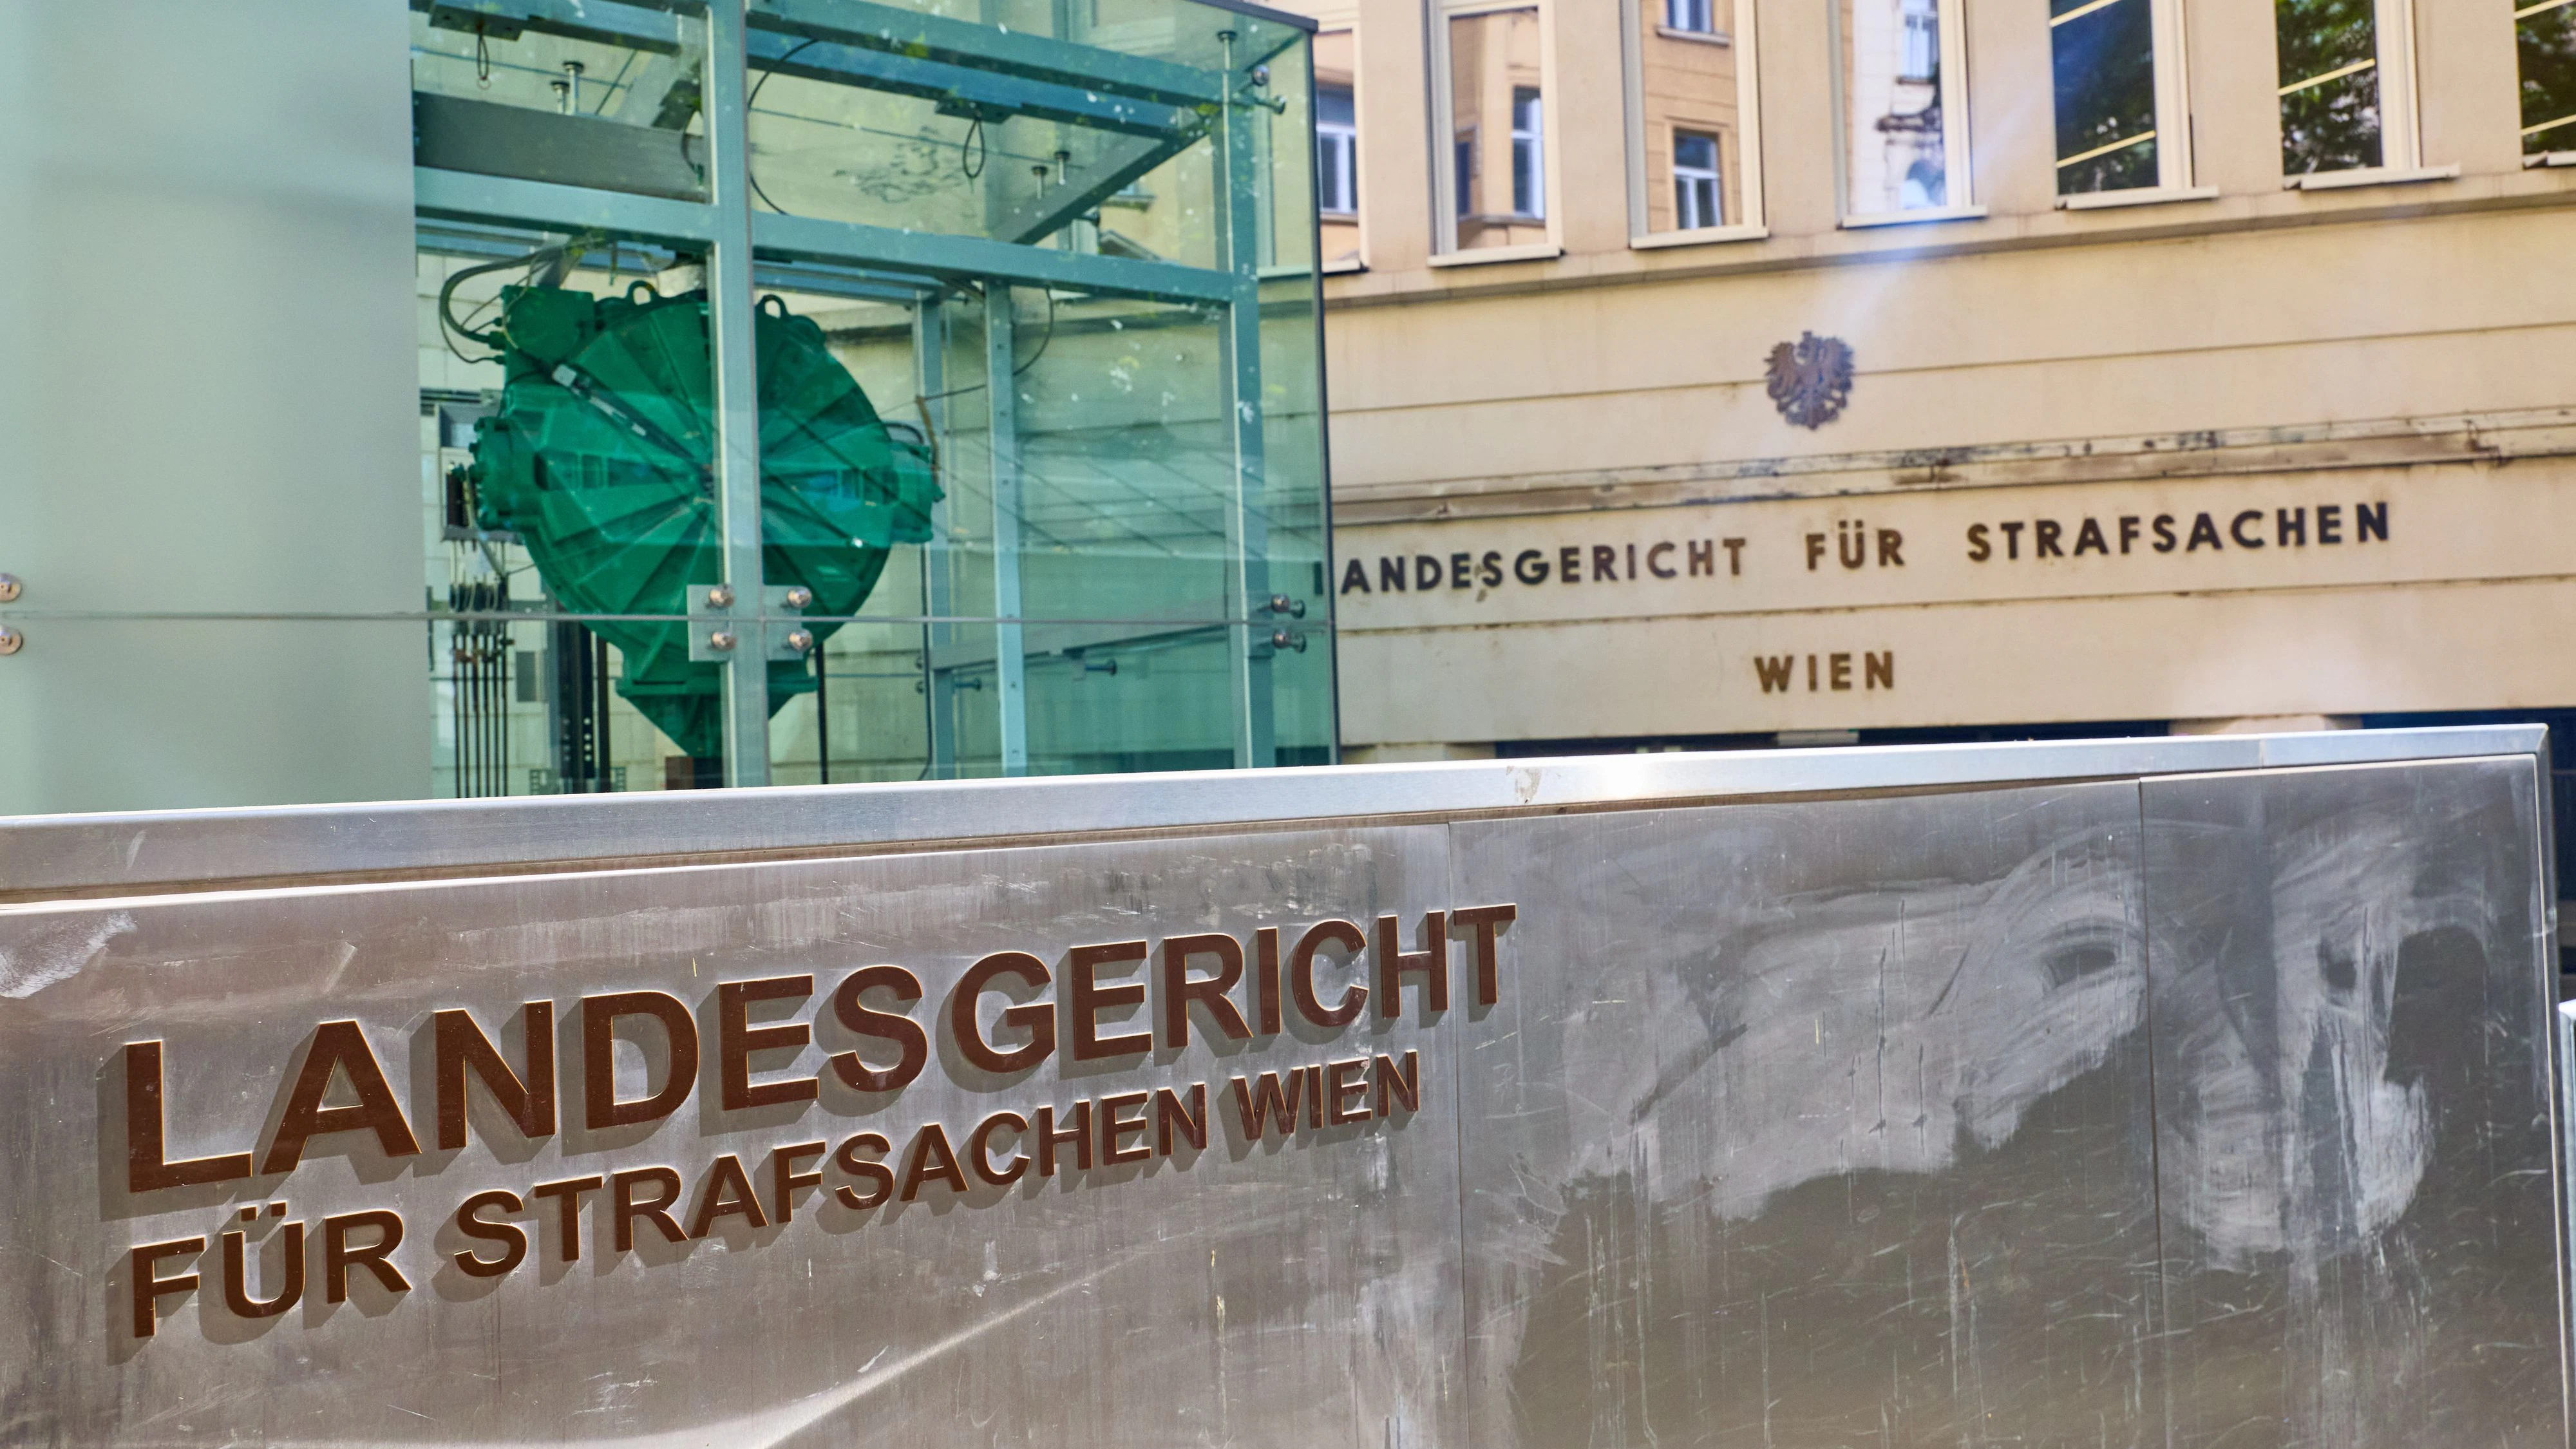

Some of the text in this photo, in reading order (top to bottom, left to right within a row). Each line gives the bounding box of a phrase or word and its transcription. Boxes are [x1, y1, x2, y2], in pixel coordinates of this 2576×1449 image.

[1806, 520, 1905, 571] FÜR
[1967, 502, 2390, 562] STRAFSACHEN
[1754, 651, 1895, 692] WIEN
[125, 903, 1517, 1193] LANDESGERICHT
[131, 1049, 1419, 1338] FÜR STRAFSACHEN WIEN
